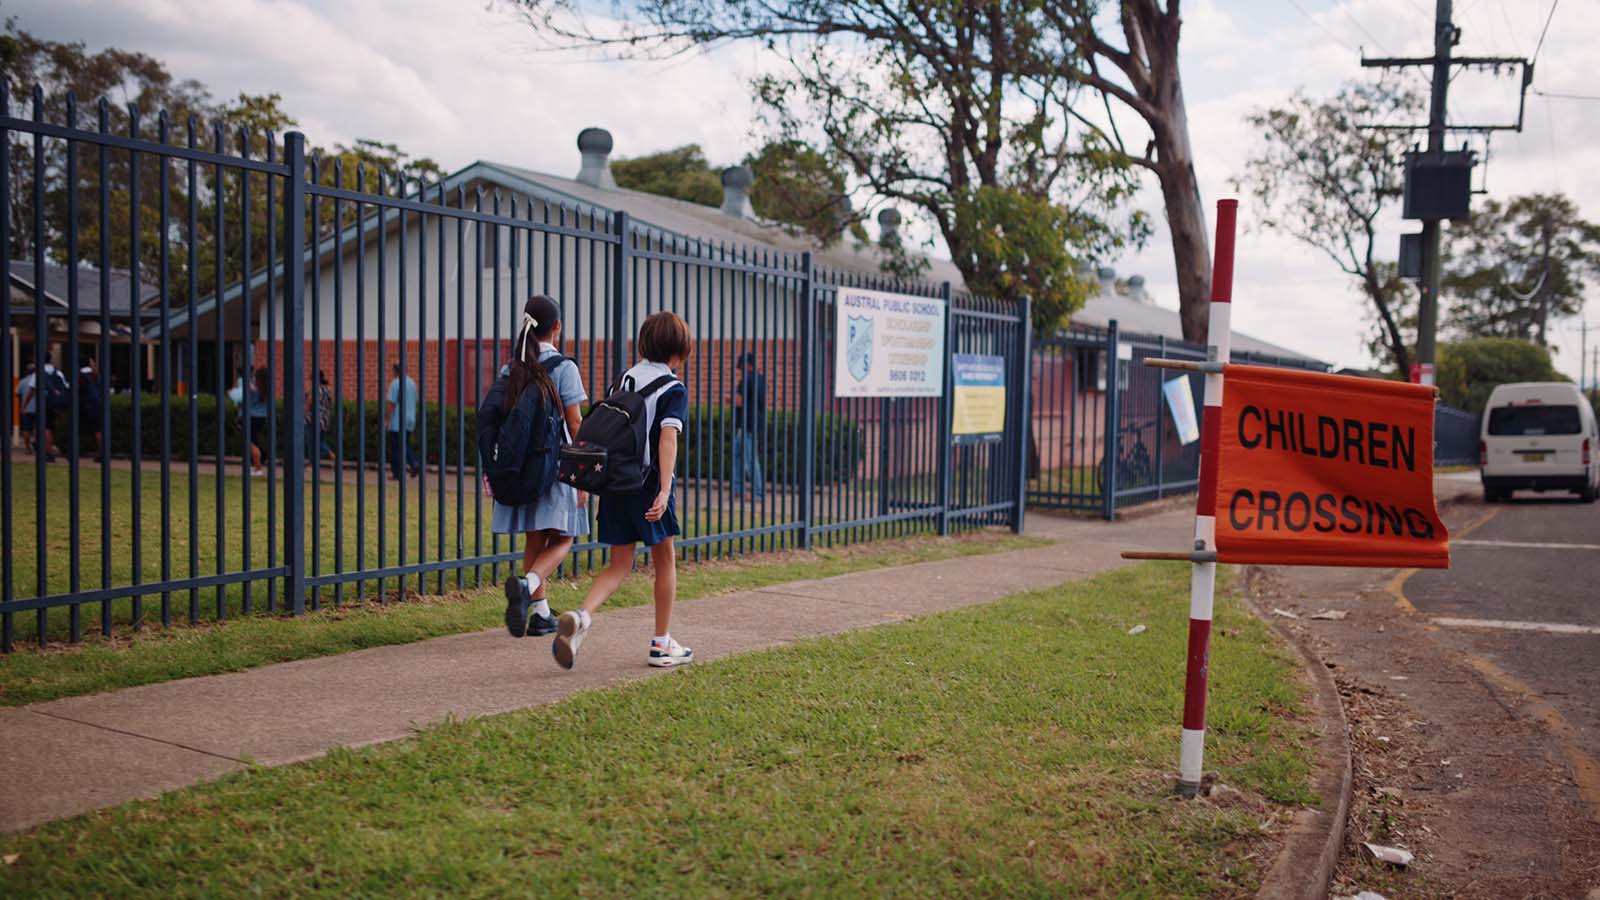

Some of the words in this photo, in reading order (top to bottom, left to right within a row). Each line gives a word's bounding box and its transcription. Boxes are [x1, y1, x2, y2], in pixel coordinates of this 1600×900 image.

[844, 294, 880, 310] AUSTRAL
[883, 299, 911, 313] PUBLIC
[912, 303, 939, 317] SCHOOL
[850, 326, 856, 343] P
[863, 353, 869, 372] S
[1238, 405, 1415, 472] CHILDREN
[1229, 488, 1434, 540] CROSSING
